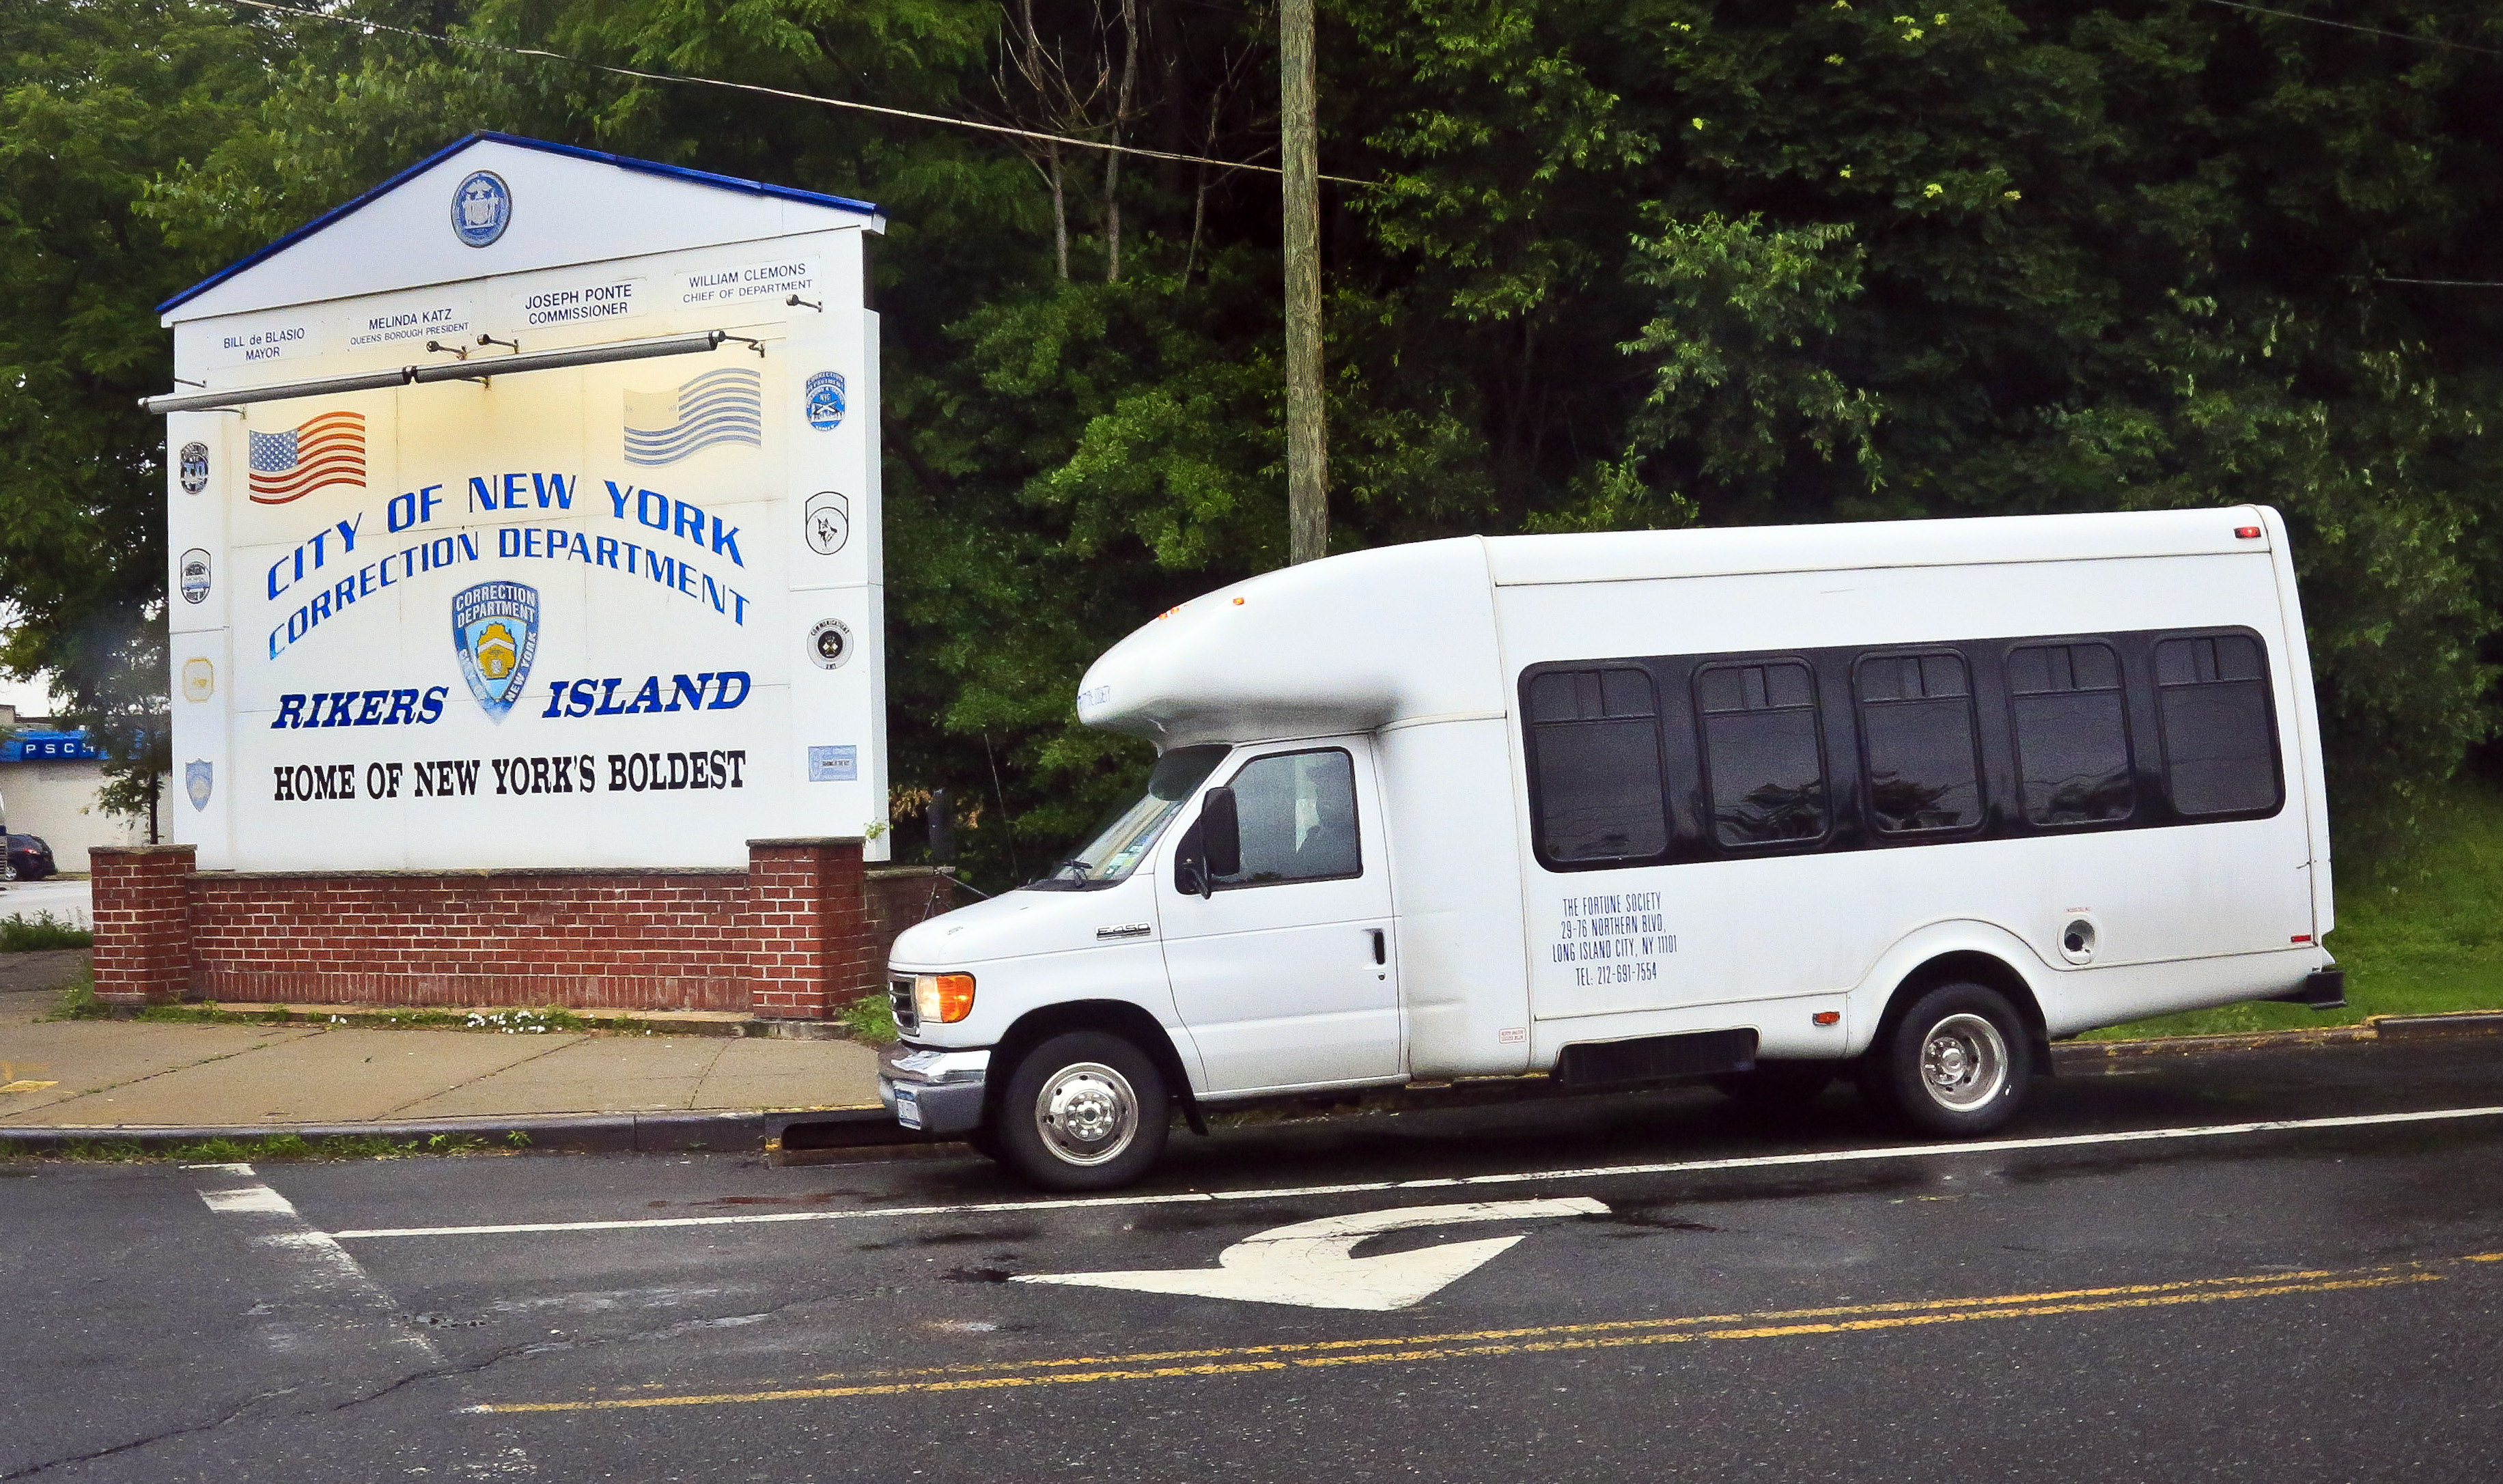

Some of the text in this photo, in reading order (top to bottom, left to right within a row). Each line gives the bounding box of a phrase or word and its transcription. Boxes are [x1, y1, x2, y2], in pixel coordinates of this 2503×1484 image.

[689, 264, 806, 288] WILLIAM CLEMONS
[525, 284, 632, 310] JOSEPH PONTE
[683, 279, 813, 303] CHIEF OF DEPARTMENT
[369, 308, 452, 330] MELINDA KATZ
[529, 302, 628, 324] COMMISSIONER
[223, 327, 305, 349] BILL de BLASIO
[350, 322, 469, 346] QUEENS BOROUGH PRESIDENT
[245, 346, 281, 361] MAYOR
[268, 473, 745, 600] CITY OF NEW YORK
[269, 529, 750, 660] CORRECTION DEPARTMENT
[456, 585, 536, 611] CORRECTION
[457, 600, 535, 628] DEPARTMENT
[505, 631, 537, 702] NEW YORK
[271, 686, 449, 729] RIKERS
[542, 671, 751, 718] ISLAND
[274, 750, 746, 801] HOME OF NEW YORK'S BOLDEST
[1563, 891, 1662, 917] THE FORTUNE SOCIETY
[1561, 920, 1587, 939] 29-76
[1592, 915, 1638, 936] NORTHERN
[1552, 935, 1678, 962] LONG ISLAND CITY, NY 11101
[1576, 962, 1658, 986] TEL: 212-691-7554
